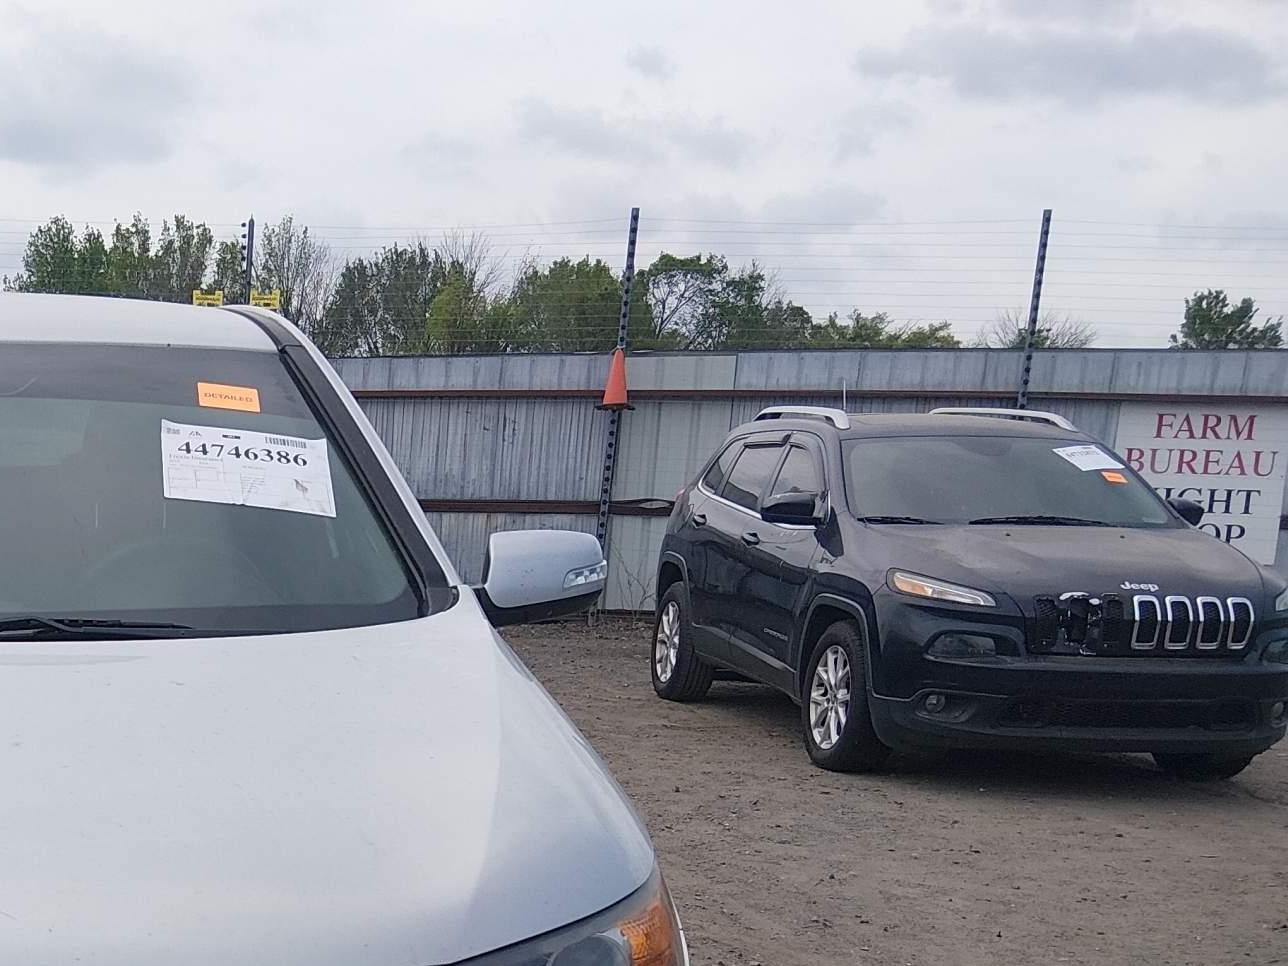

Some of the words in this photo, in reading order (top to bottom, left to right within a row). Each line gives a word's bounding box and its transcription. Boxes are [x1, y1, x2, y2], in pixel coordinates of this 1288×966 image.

[203, 392, 253, 403] DETAILED
[1153, 413, 1258, 441] FARM
[177, 441, 308, 467] 44746386
[1125, 448, 1279, 477] BUREAU
[1120, 581, 1159, 592] Jeep
